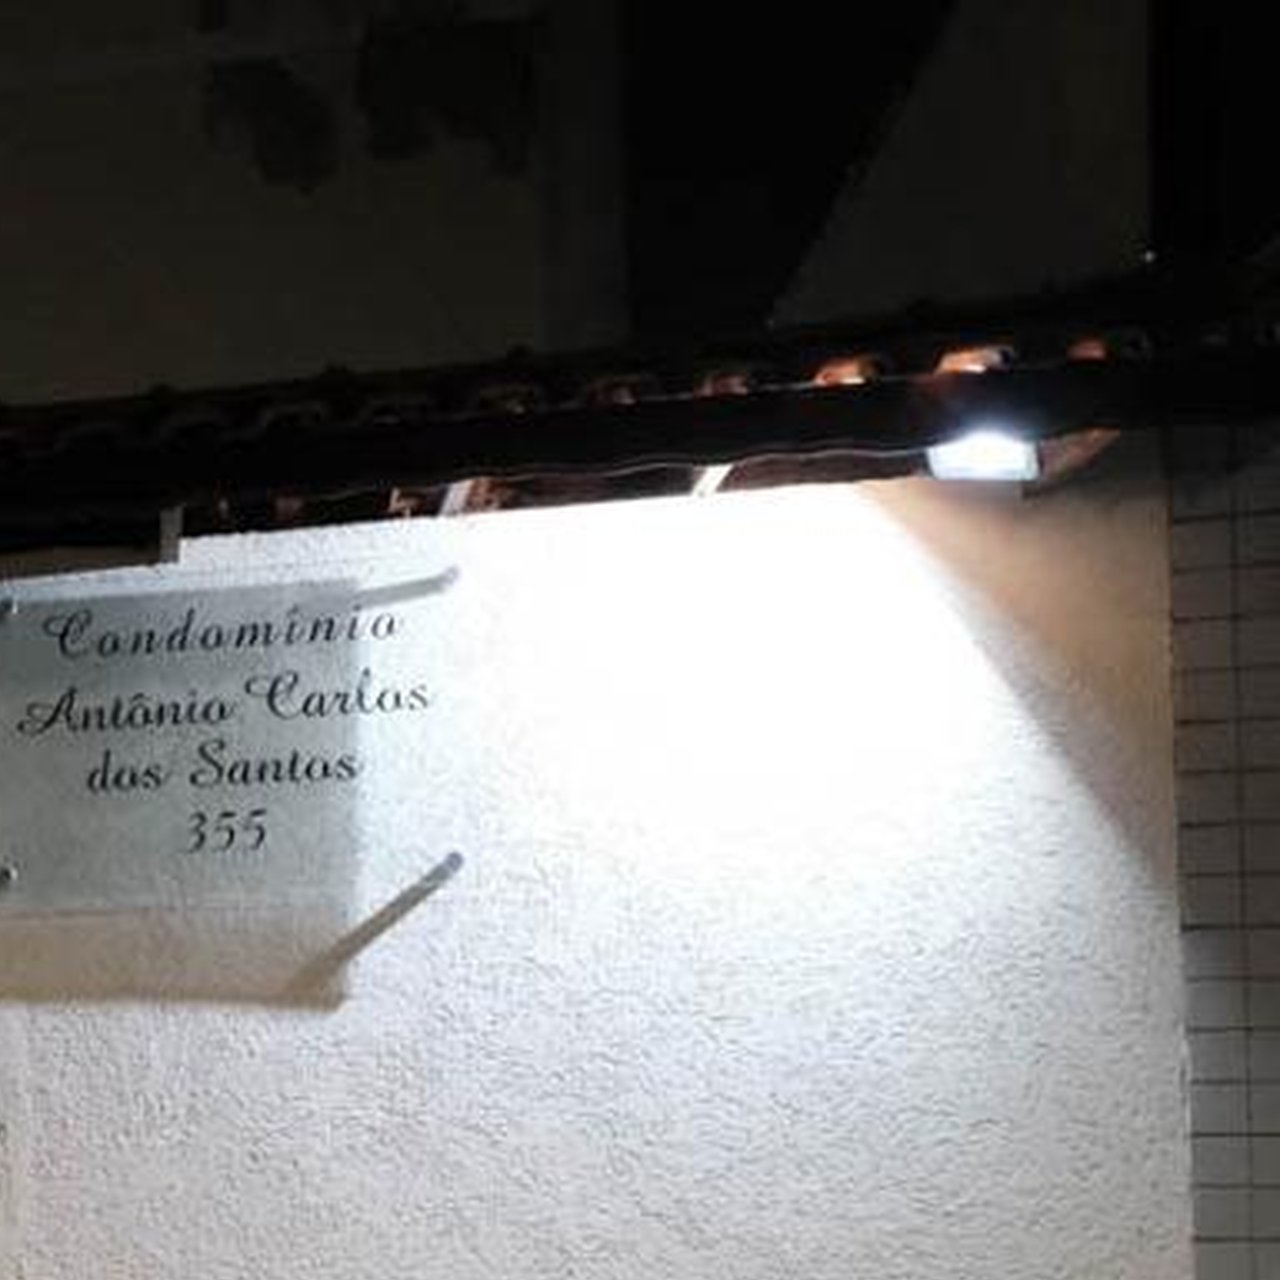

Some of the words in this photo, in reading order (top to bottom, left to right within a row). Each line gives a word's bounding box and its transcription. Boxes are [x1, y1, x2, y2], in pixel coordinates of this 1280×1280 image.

[16, 685, 233, 736] Antônio
[244, 667, 429, 720] Carlos
[86, 749, 165, 794] dos
[188, 739, 362, 789] Santos
[186, 808, 268, 854] 355
